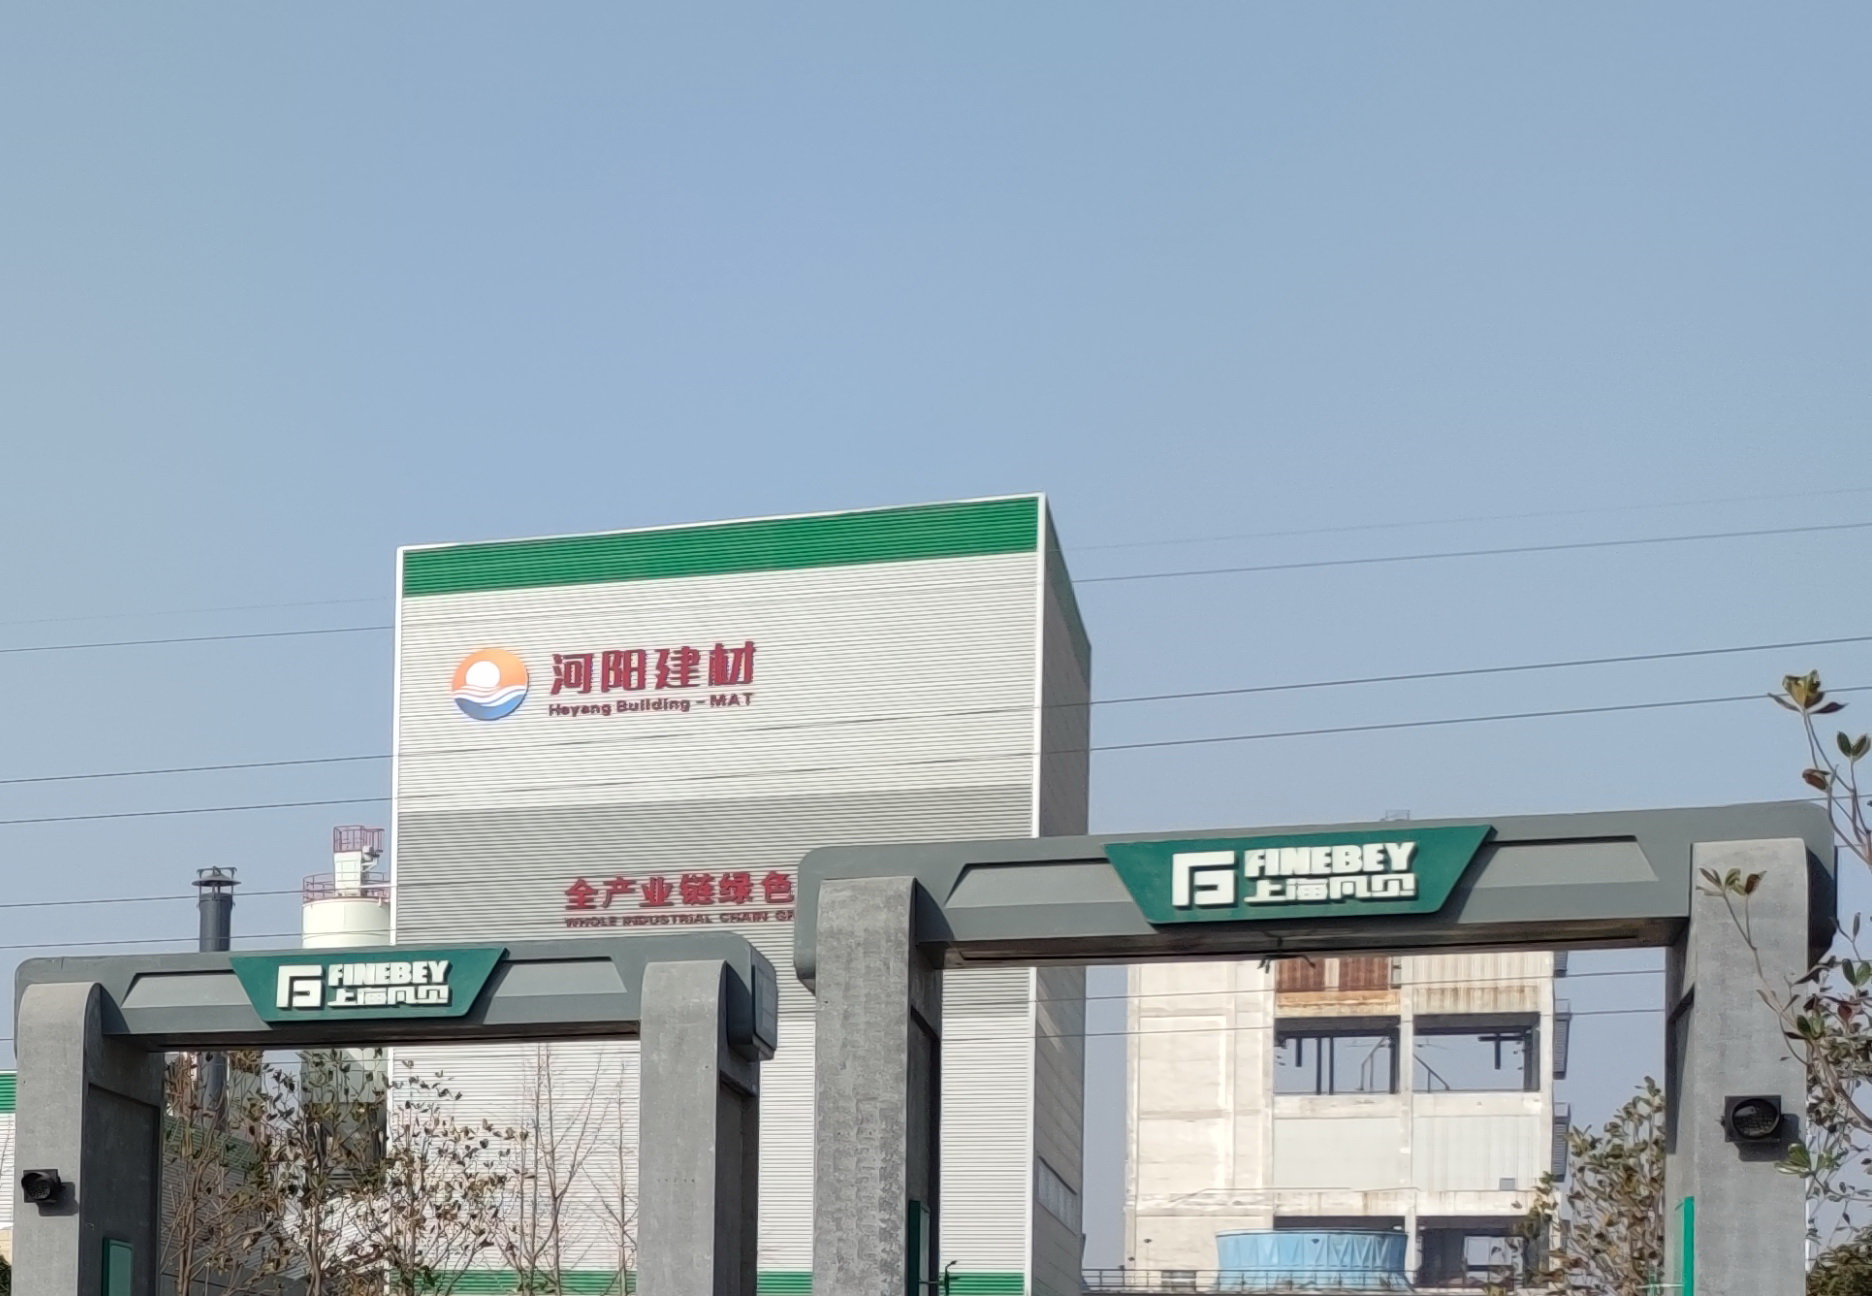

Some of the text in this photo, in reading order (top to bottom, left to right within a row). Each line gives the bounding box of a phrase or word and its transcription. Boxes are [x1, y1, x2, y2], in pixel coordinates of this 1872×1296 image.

[550, 640, 757, 695] 河阳建材
[548, 702, 612, 717] Heyang
[616, 698, 691, 713] Building
[1244, 842, 1416, 877] FINEBEY
[564, 870, 795, 911] 全产业链绿色
[327, 960, 449, 987] FINEBEY
